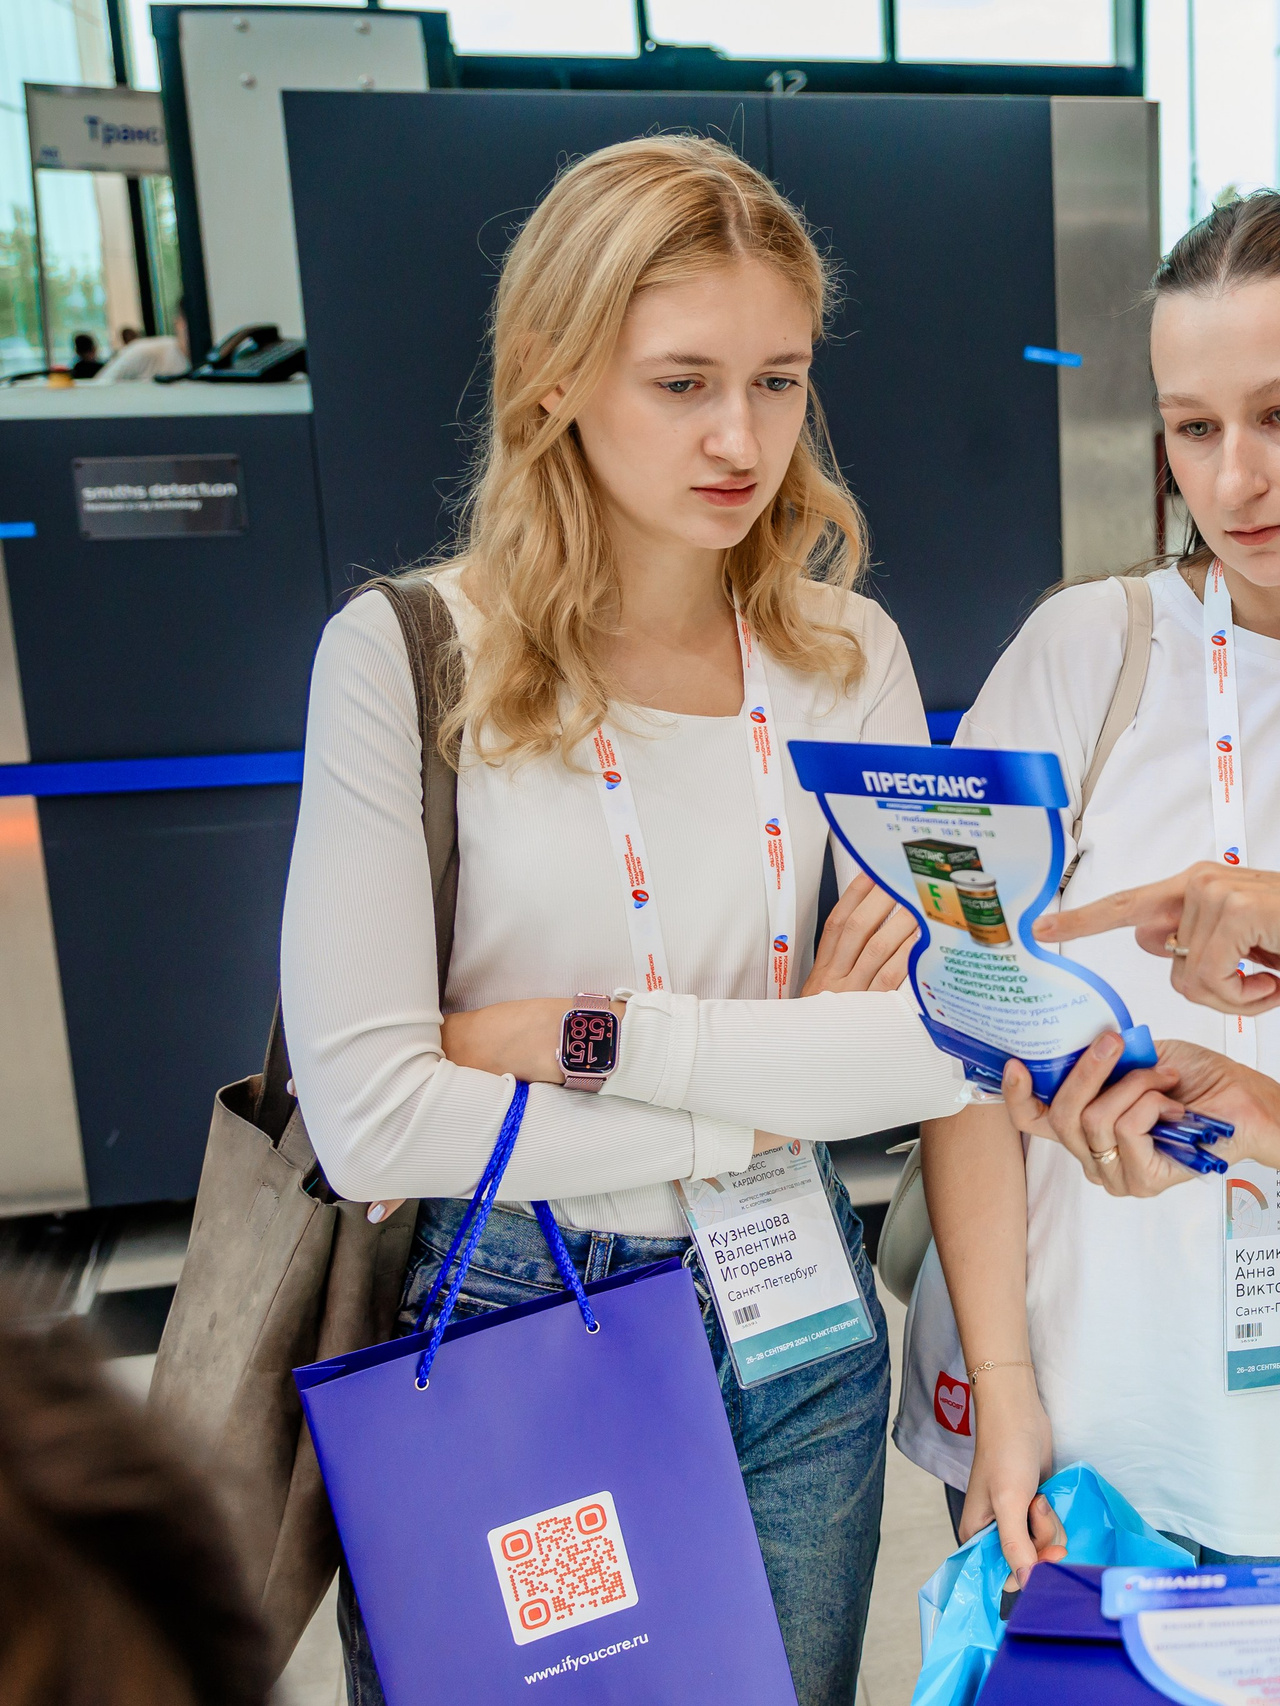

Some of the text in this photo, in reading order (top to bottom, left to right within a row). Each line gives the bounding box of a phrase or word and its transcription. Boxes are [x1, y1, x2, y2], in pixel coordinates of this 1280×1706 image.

[939, 946, 1017, 962] СПОСОБСТВУЕТ
[944, 956, 1020, 973] ОБЕСПЕЧЕНИЮ
[944, 965, 1028, 983] КОМПЛЕКСНОГО
[947, 983, 995, 1001] ПАЦИЕНТА
[996, 995, 1011, 1003] ЗА
[953, 977, 1025, 994] КОНТРОЛЯ АД
[569, 1040, 598, 1064] 15
[732, 1167, 786, 1188] КАРДИОЛОГОВ
[708, 1211, 790, 1249] Кузнецова
[715, 1229, 797, 1265] Валентина
[720, 1248, 793, 1282] Игоревна
[1235, 1264, 1275, 1280] Анна
[728, 1263, 819, 1302] Санкт-Петербург
[764, 1339, 795, 1359] СЕНТЯБРЯ
[794, 1334, 808, 1348] 2024
[811, 1316, 860, 1341] САНКТ-ПЕТЕРБУРГ
[1139, 1573, 1227, 1590] SERVIER
[524, 1633, 649, 1685] www.ifyoucare.ru
